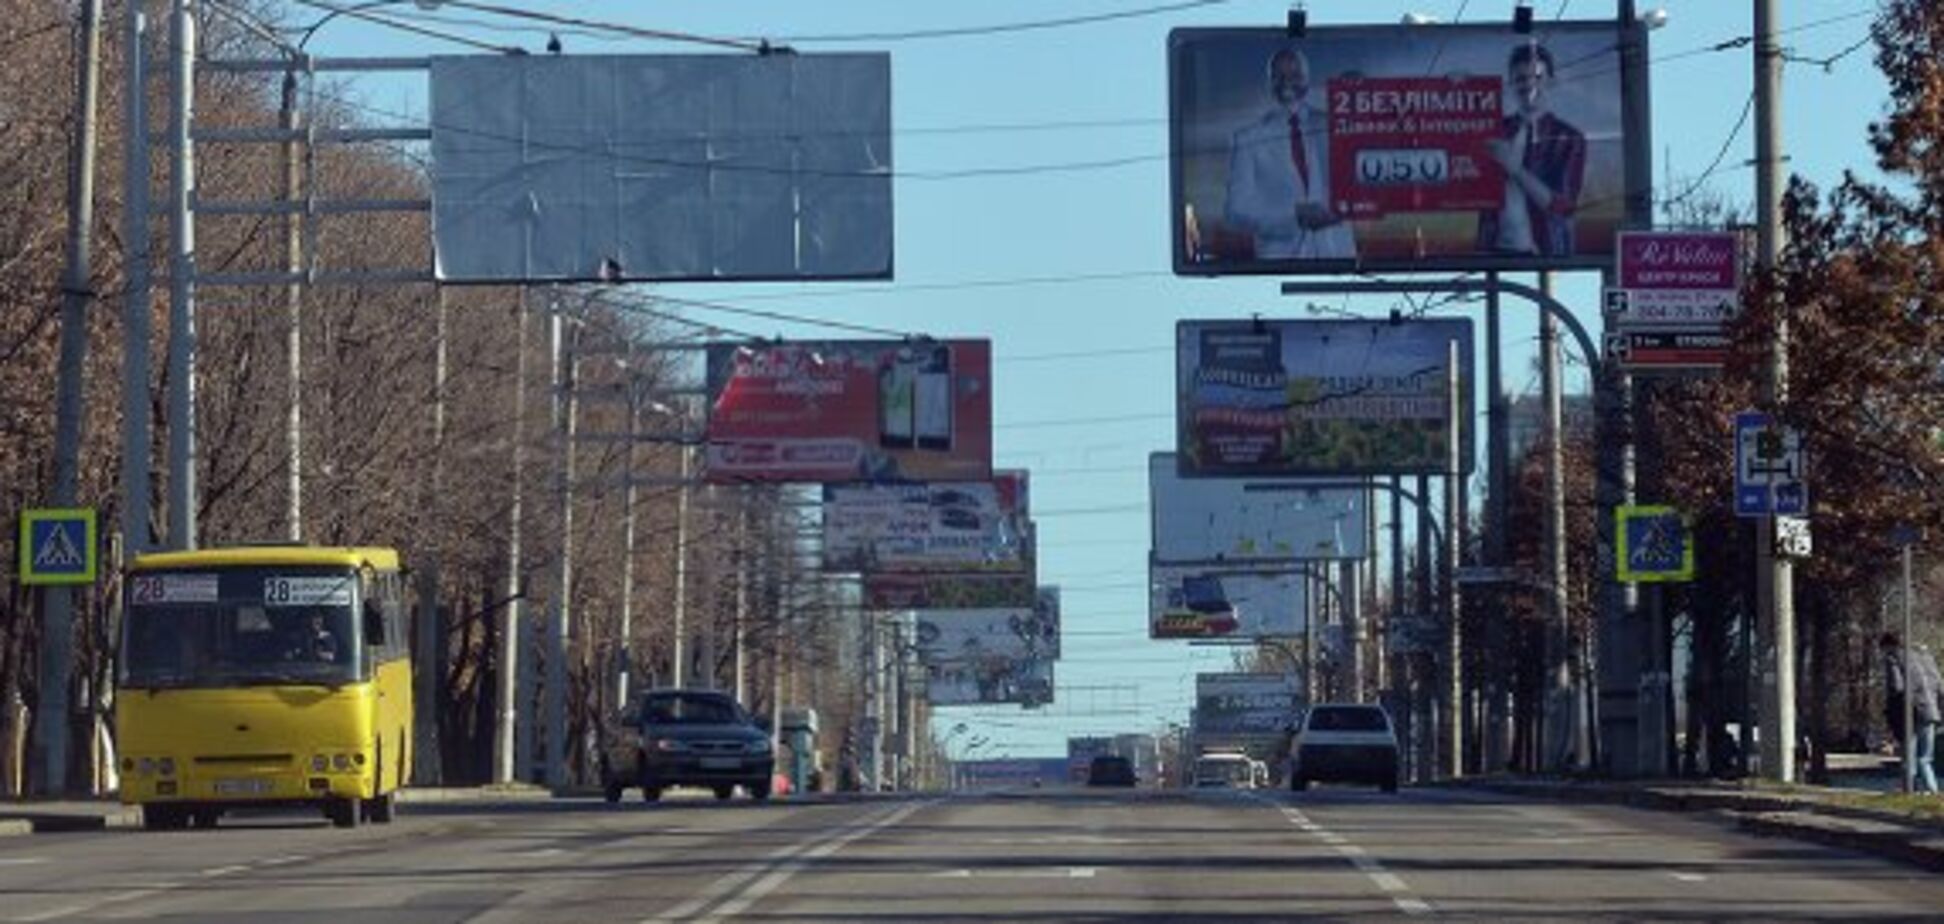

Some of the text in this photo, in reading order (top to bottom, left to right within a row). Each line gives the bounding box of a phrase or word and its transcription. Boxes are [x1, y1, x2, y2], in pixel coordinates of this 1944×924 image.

[1335, 90, 1497, 114] 2 БЕЗЛІМІТИ
[136, 578, 165, 601] 28
[267, 579, 290, 602] 28
